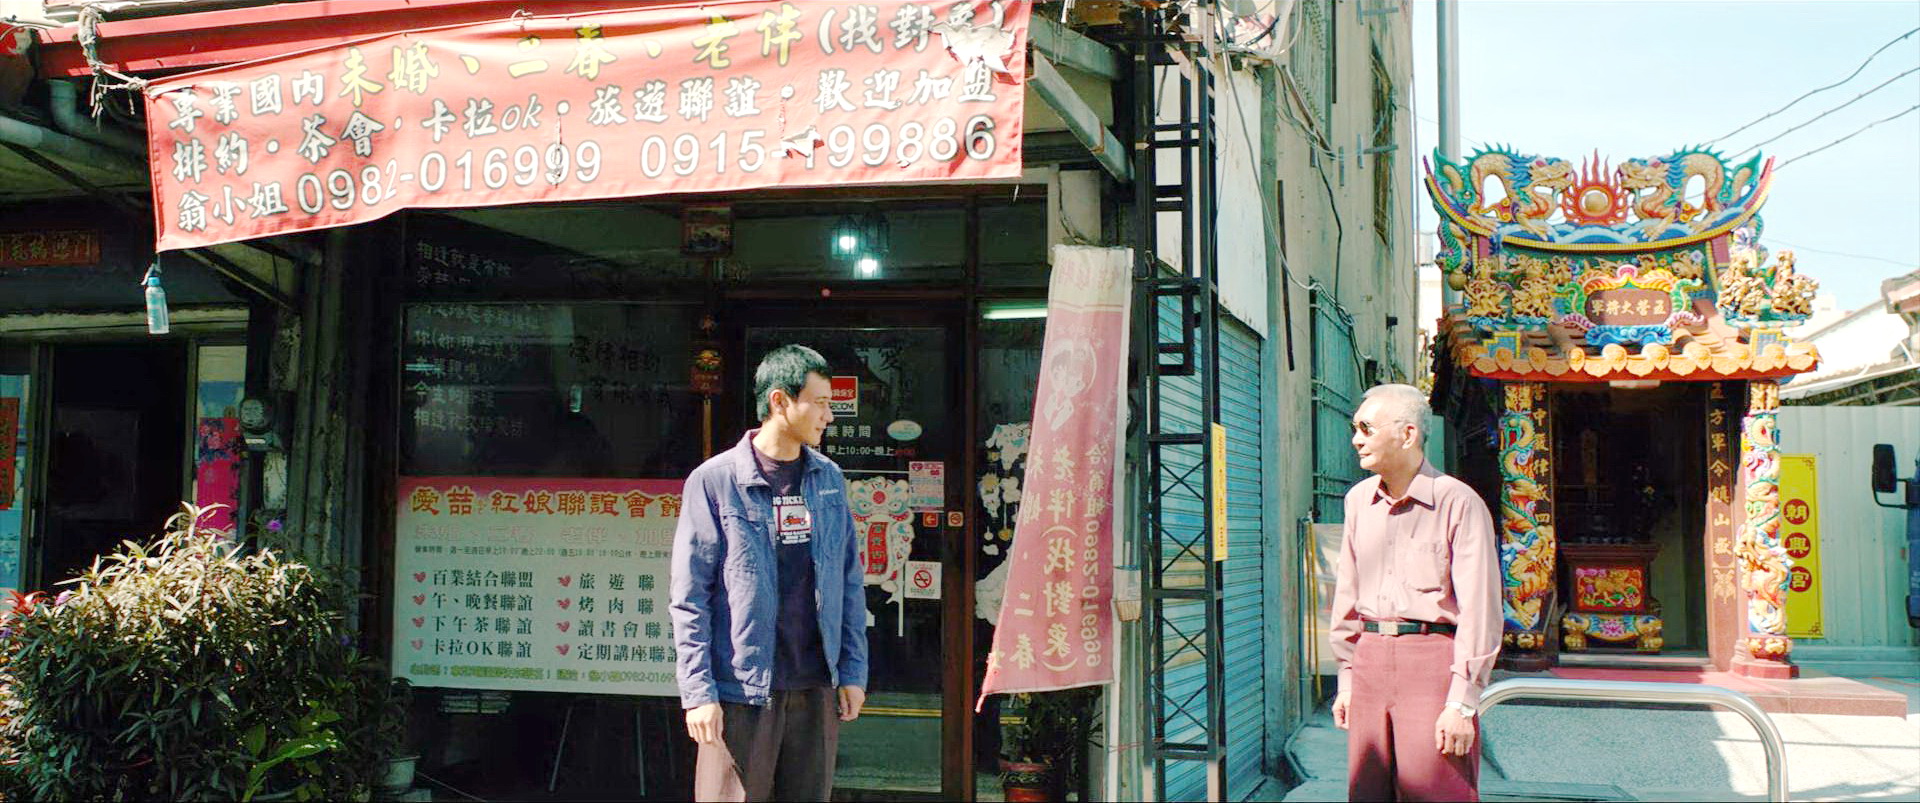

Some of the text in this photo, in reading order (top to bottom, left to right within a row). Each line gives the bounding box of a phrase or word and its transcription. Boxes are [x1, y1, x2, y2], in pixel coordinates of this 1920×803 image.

[827, 425, 871, 438] 業時間
[773, 496, 805, 505] IG TICKE
[1785, 503, 1811, 588] 朝興宮
[432, 570, 533, 588] 百業結合聯盟
[579, 573, 655, 591] 旅遊聯
[432, 593, 533, 612] 午、晚餐聯誼
[578, 596, 655, 615] 烤肉聯
[432, 616, 533, 635] 下午茶聯誼
[432, 639, 532, 658] 卡拉OK聯誼
